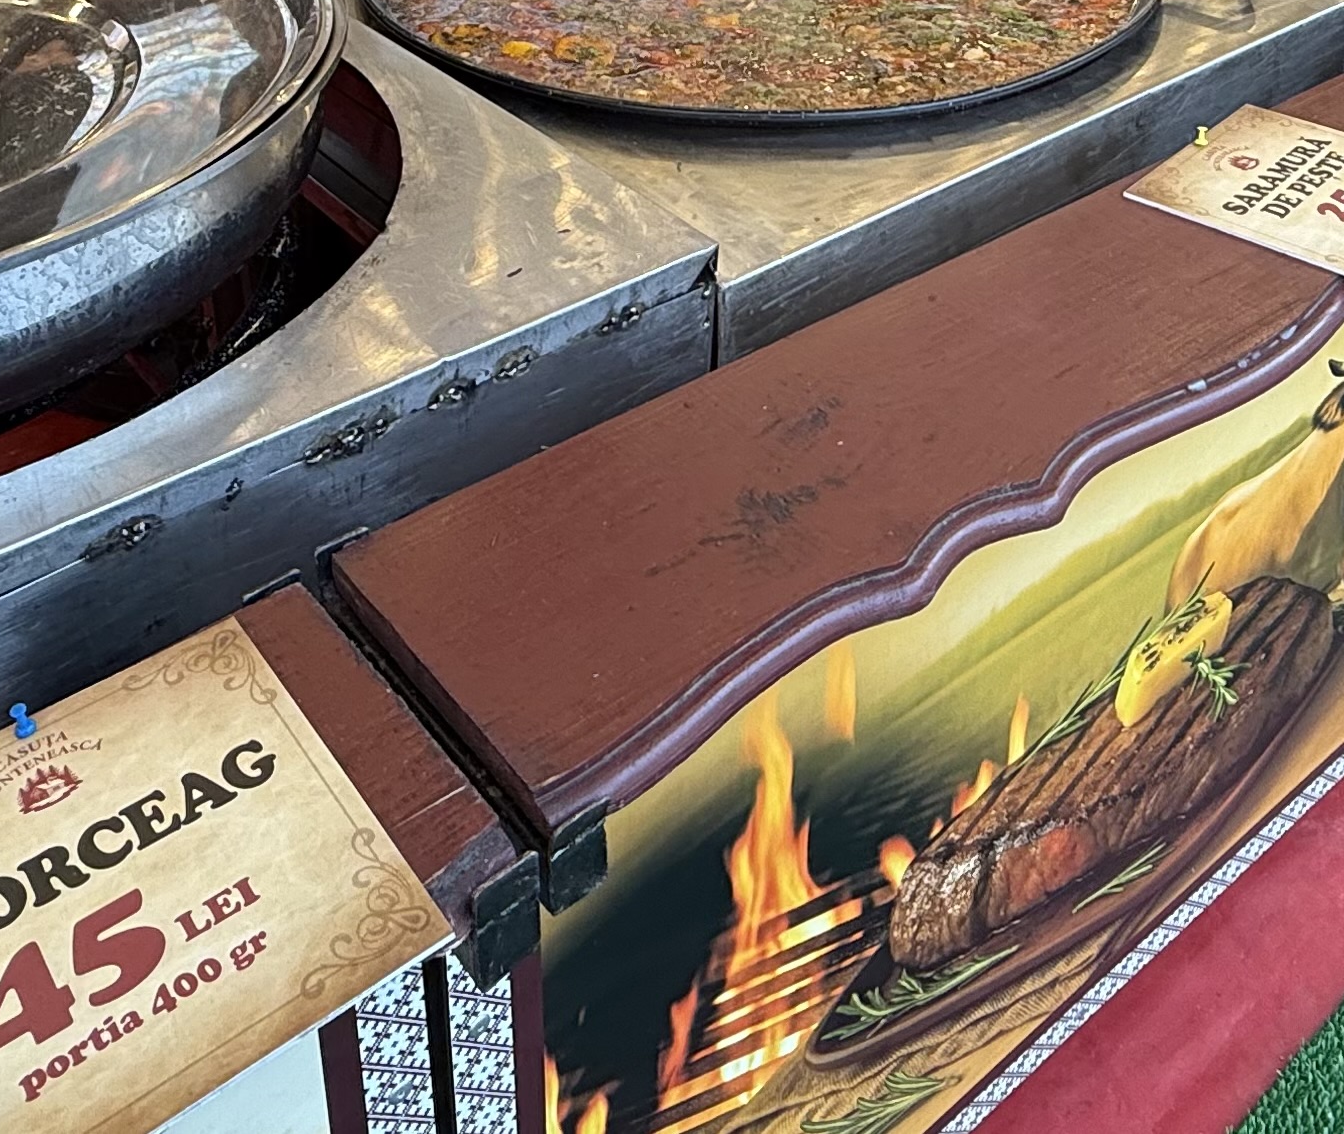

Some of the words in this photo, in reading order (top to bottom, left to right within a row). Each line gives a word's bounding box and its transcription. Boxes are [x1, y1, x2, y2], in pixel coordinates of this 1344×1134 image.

[1222, 136, 1332, 215] SARAMURĂ
[1260, 193, 1303, 219] DE
[174, 876, 261, 942] LEI
[18, 1010, 144, 1102] portia
[152, 957, 222, 1015] 400
[229, 930, 267, 971] gr
